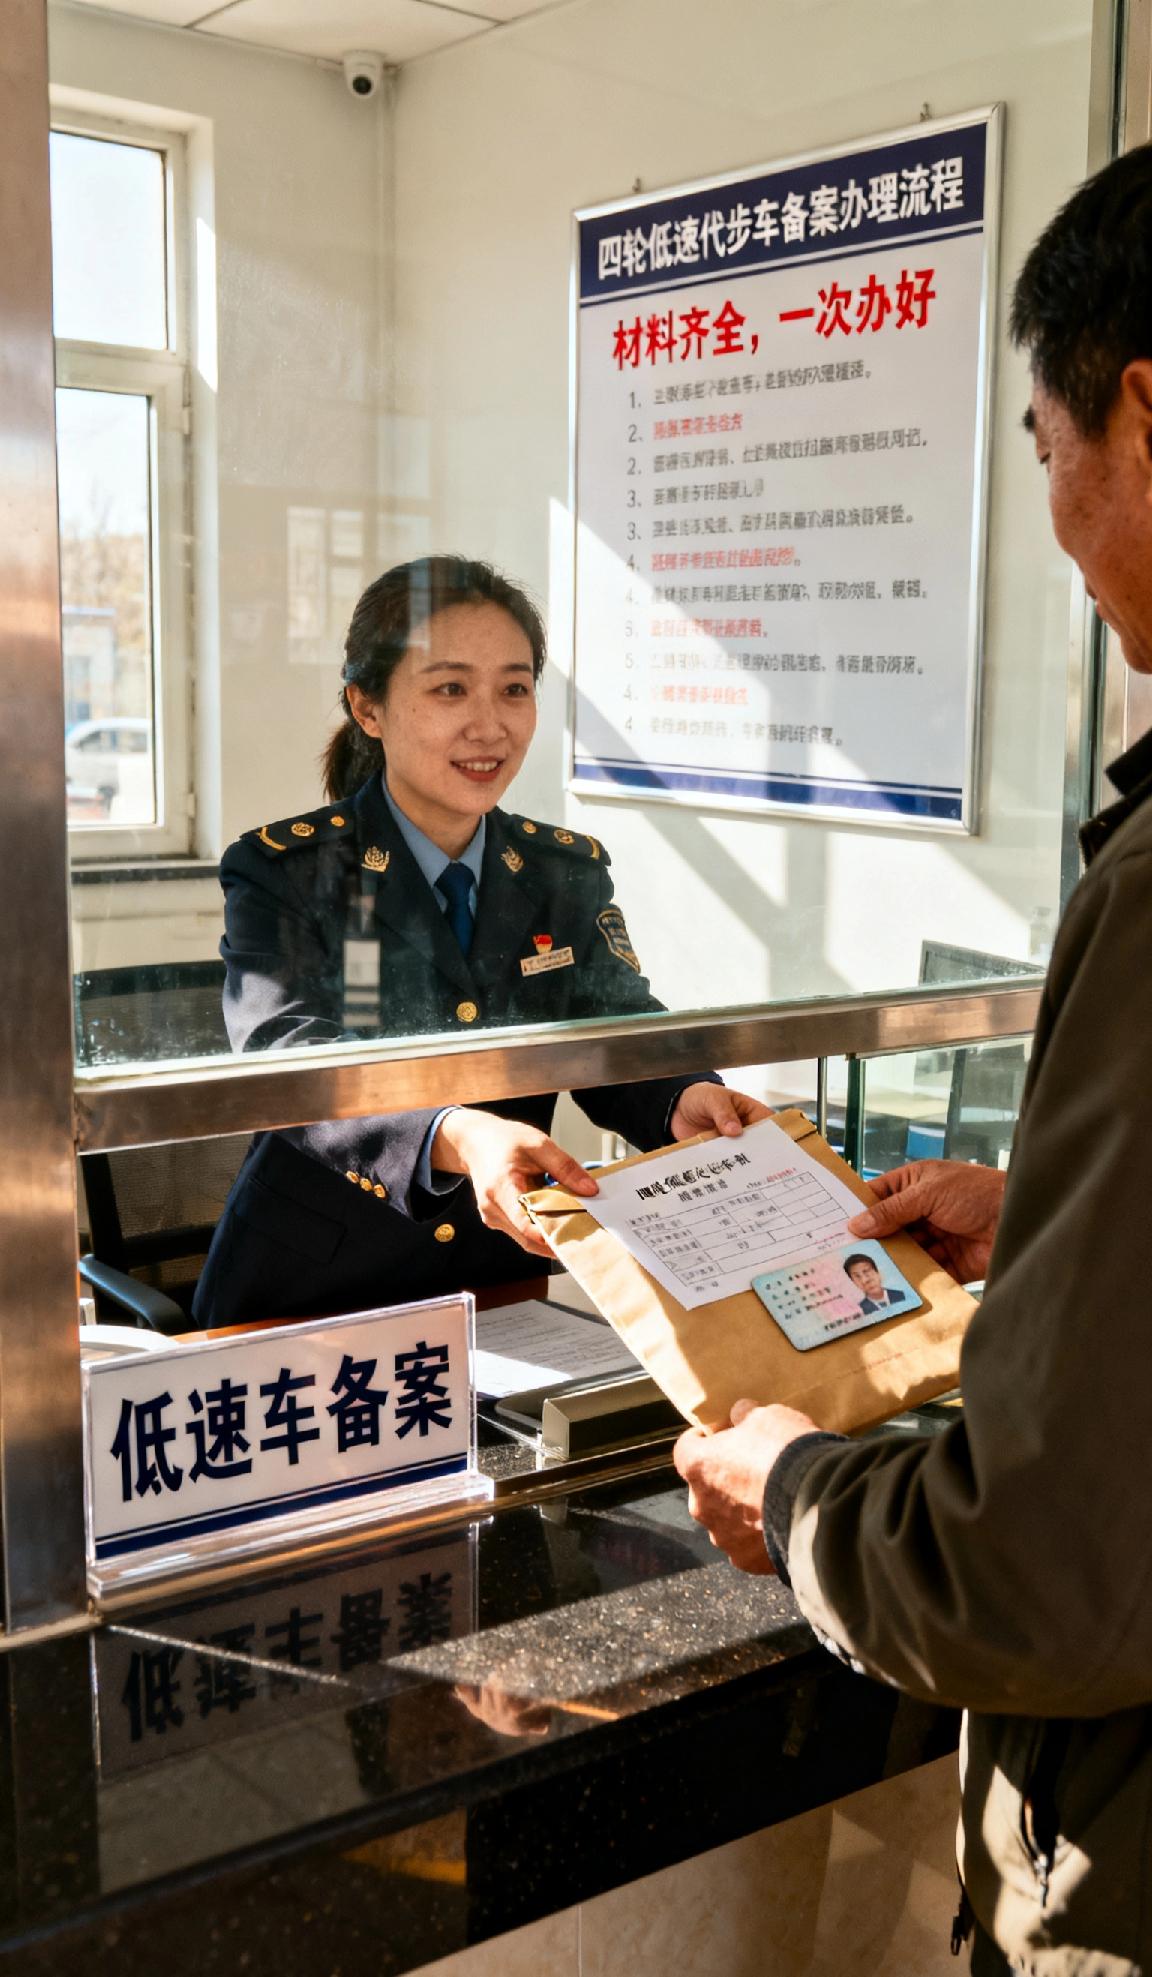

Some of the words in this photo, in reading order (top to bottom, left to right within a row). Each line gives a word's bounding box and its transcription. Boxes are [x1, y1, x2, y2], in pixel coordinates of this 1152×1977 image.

[598, 156, 964, 280] 四轮低速代步车备案办理流程
[612, 268, 937, 371] 材料齐全，一次办好
[110, 1341, 453, 1502] 低速车备案
